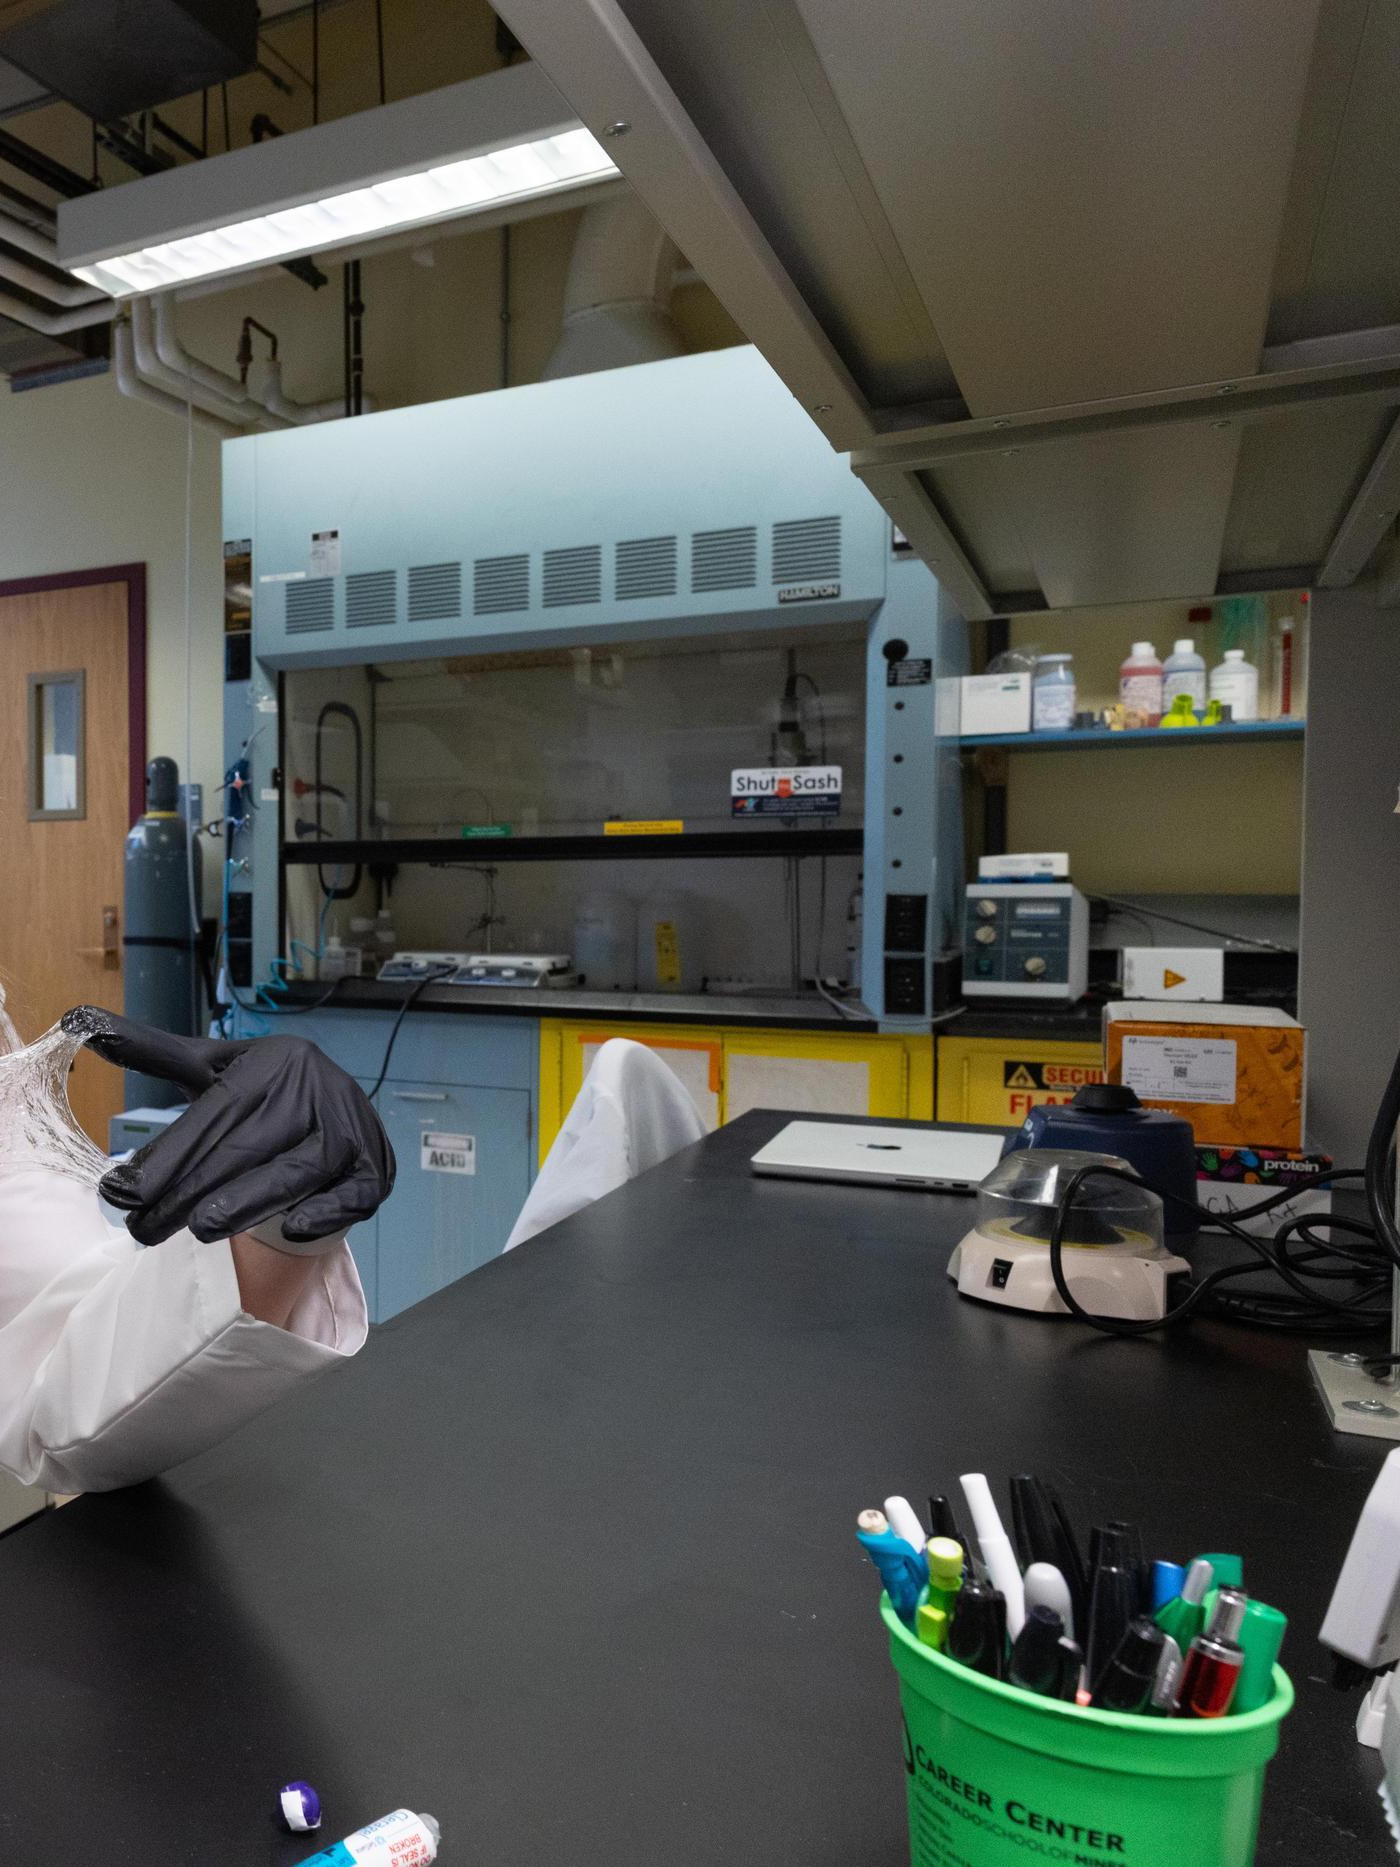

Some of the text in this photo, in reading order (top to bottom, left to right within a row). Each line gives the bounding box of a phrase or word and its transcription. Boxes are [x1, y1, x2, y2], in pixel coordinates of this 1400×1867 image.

[736, 773, 839, 792] Shut Sash
[428, 1150, 466, 1168] ACID
[1264, 1159, 1320, 1172] protein
[915, 1743, 994, 1813] CAREER
[1004, 1799, 1126, 1853] CENTER
[388, 1833, 421, 1855] BROKEN
